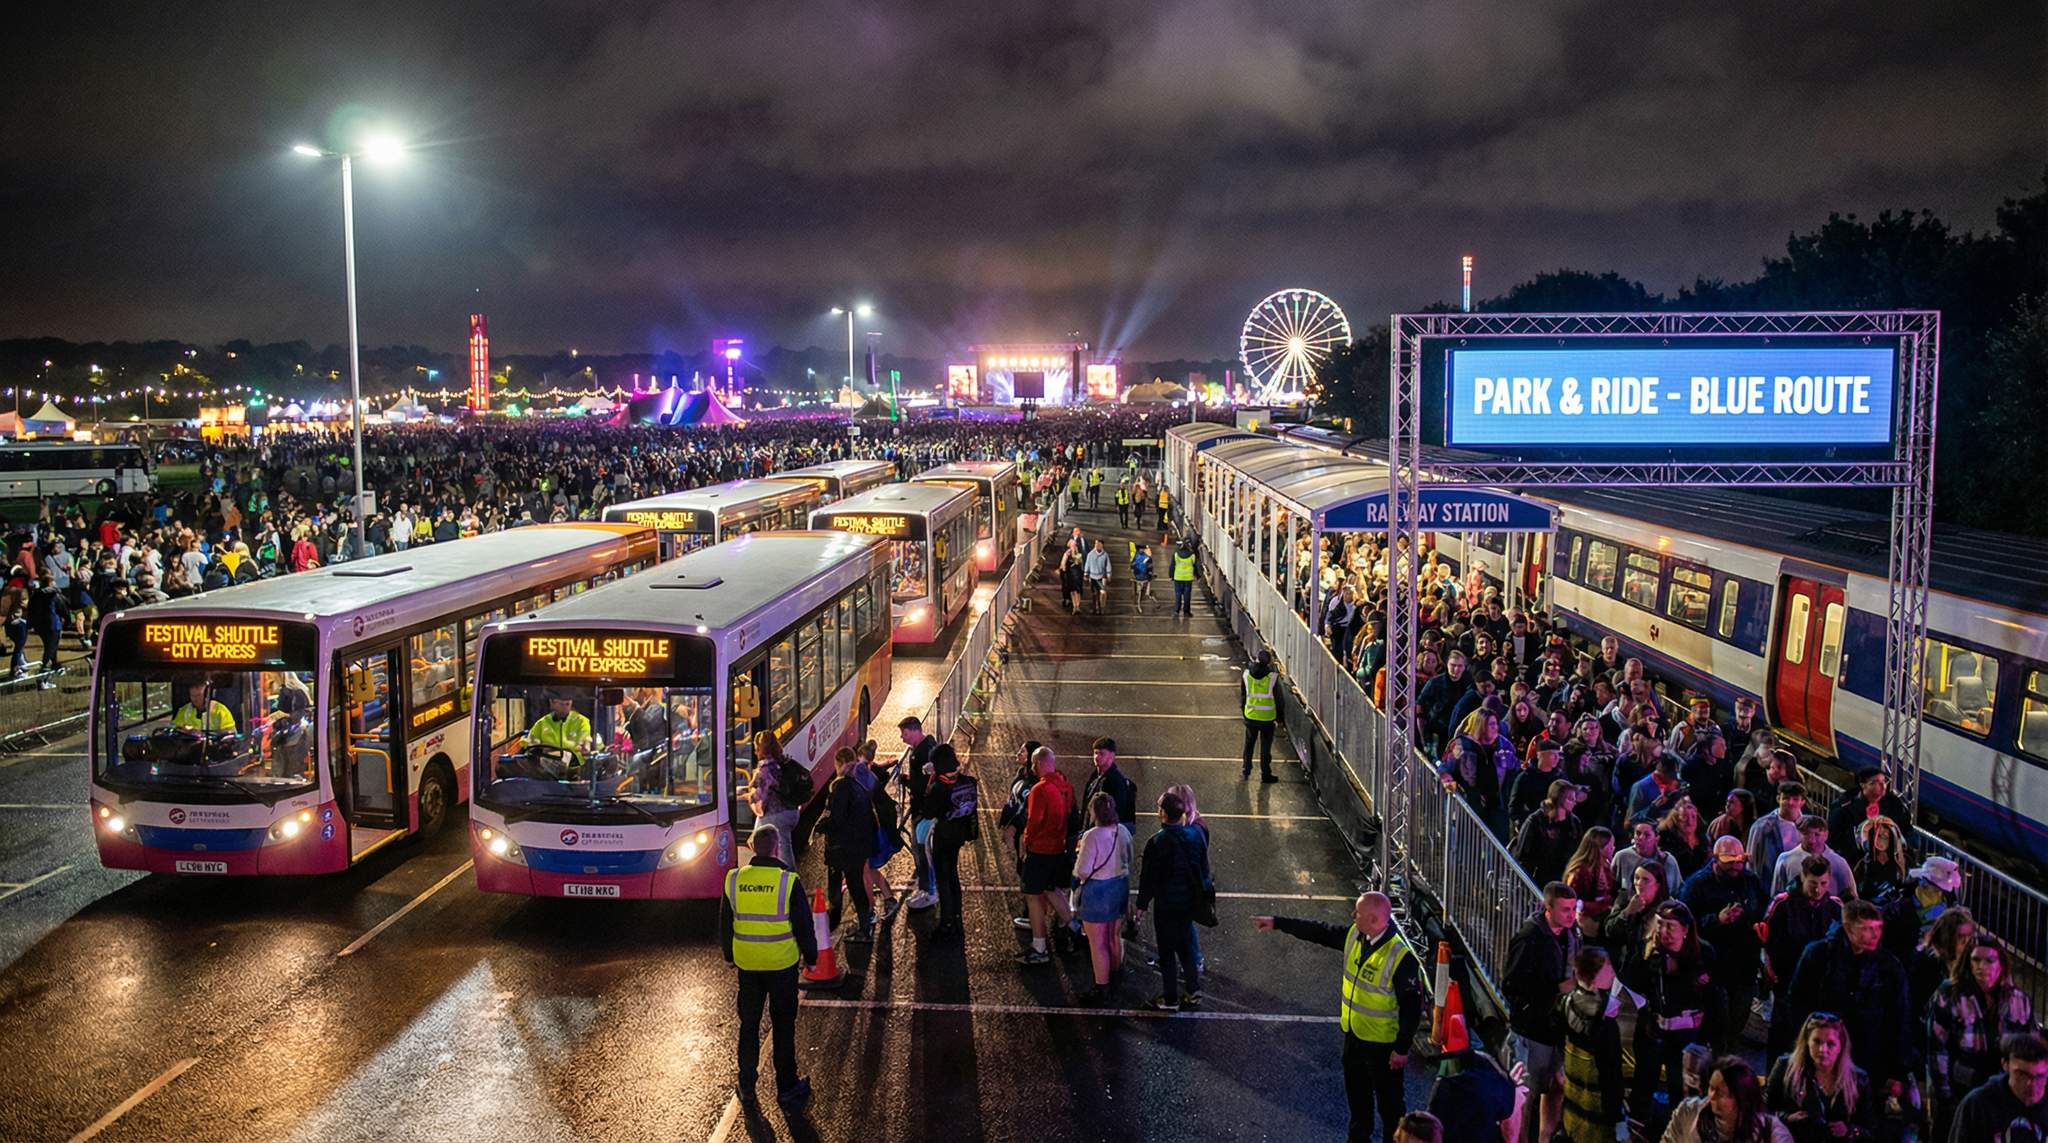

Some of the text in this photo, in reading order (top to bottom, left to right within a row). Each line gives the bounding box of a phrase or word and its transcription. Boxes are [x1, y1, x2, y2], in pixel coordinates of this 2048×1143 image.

[1473, 376, 1872, 416] PARK & RIDE - BLUE ROUTE
[1366, 502, 1510, 523] RAWAY STATION
[145, 624, 279, 644] FESTIVAL SHUTTLE
[171, 643, 200, 658] CITY
[202, 643, 257, 659] EXPRESS
[528, 637, 669, 658] FESTIVAL SHUTTLE
[556, 657, 587, 673] CITY
[589, 657, 647, 673] EXPRESS
[738, 883, 776, 893] SECURITY
